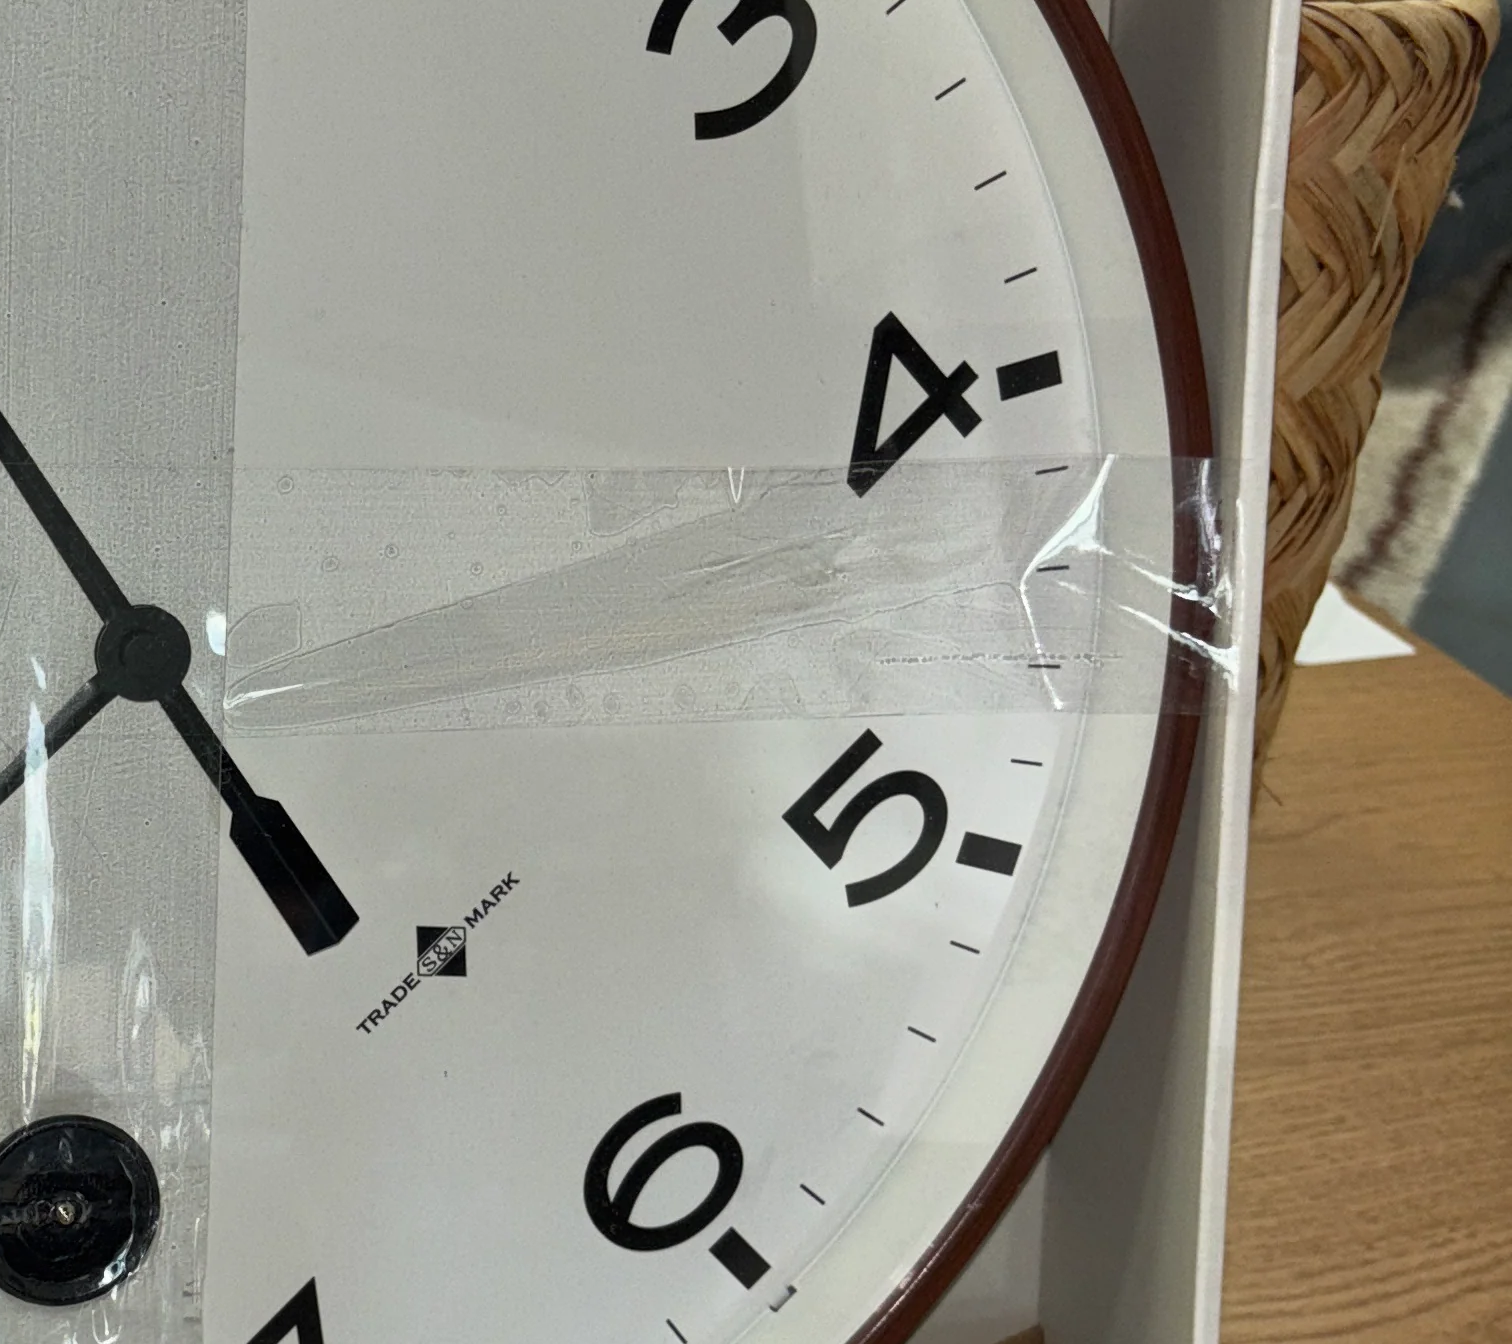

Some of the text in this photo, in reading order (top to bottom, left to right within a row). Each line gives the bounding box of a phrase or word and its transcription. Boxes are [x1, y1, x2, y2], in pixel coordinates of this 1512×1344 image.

[847, 311, 982, 498] 4
[782, 728, 948, 908] 5
[356, 871, 521, 1035] TRADE S&N MARK
[584, 1092, 744, 1252] 6
